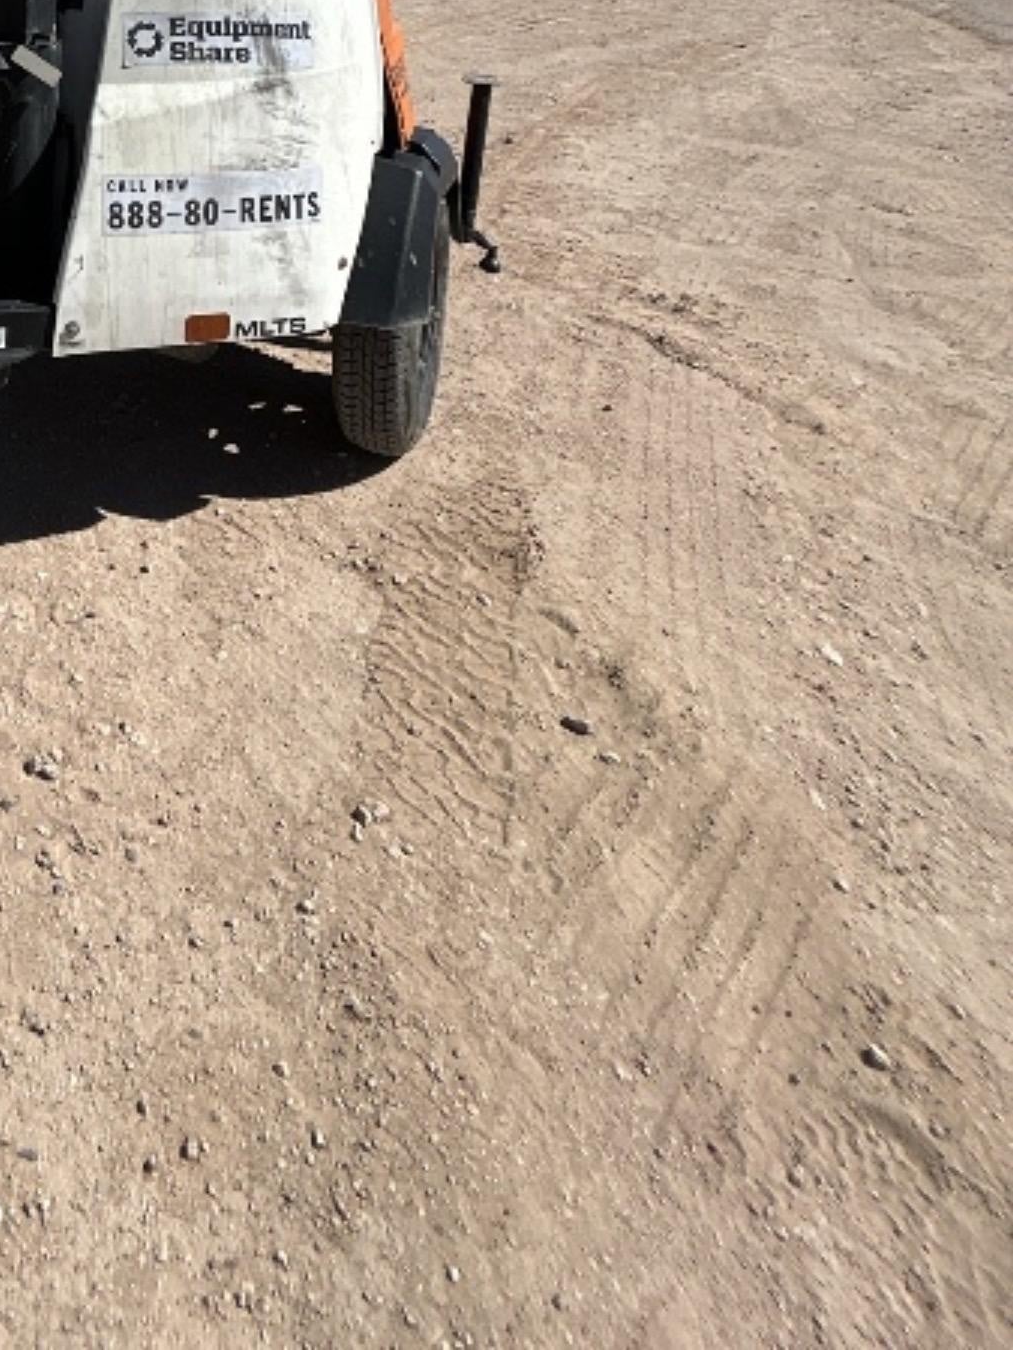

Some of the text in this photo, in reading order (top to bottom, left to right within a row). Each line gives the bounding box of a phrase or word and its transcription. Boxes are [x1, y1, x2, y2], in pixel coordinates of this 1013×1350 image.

[169, 15, 312, 41] Equipment
[169, 41, 252, 64] Share
[108, 191, 321, 230] 888-80-RENTS
